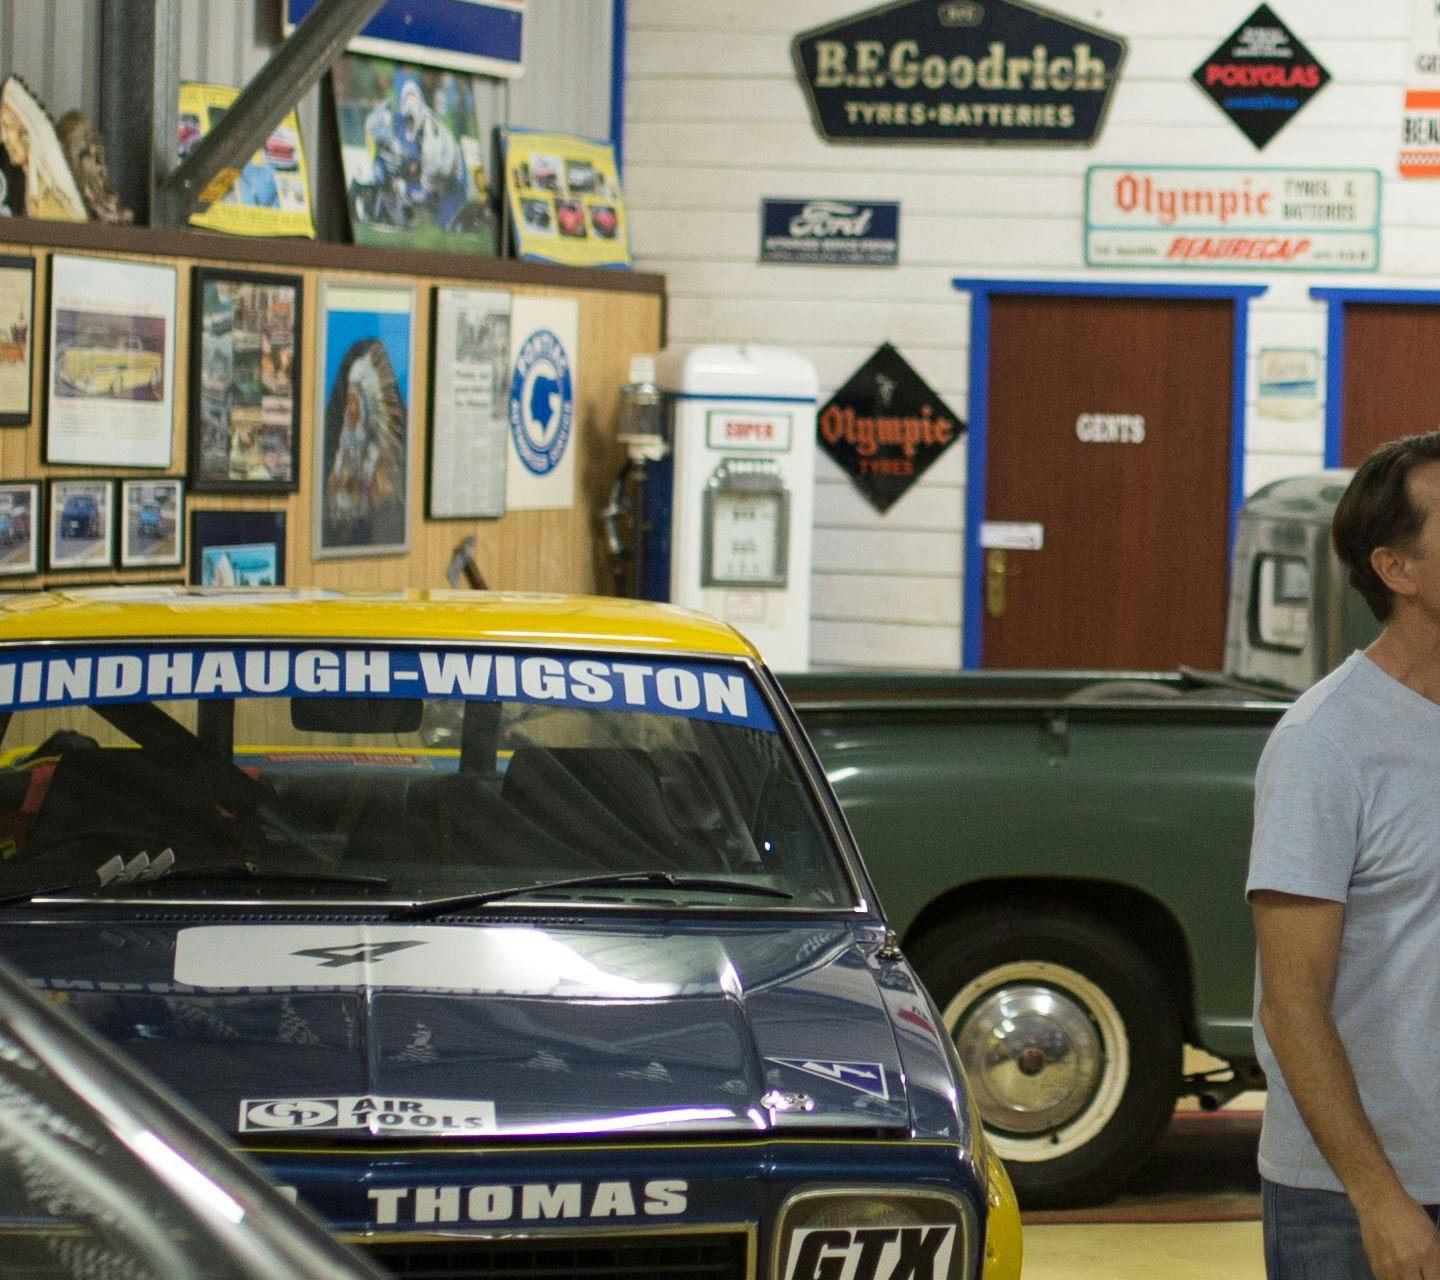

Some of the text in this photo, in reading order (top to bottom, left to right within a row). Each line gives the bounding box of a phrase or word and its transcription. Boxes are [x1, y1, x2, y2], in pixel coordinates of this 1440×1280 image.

[1205, 63, 1321, 89] POLYGLAS
[1114, 171, 1271, 226] Olympic
[788, 201, 874, 237] Ford
[516, 331, 570, 379] PONTIAC
[724, 421, 774, 440] SUPER
[818, 403, 954, 458] Olympic
[1075, 412, 1147, 444] GENTS
[858, 458, 913, 476] TYRES
[292, 937, 426, 969] 4
[350, 1099, 424, 1114] AIR
[352, 1112, 485, 1130] TOOLS
[367, 1179, 689, 1224] THOMAS
